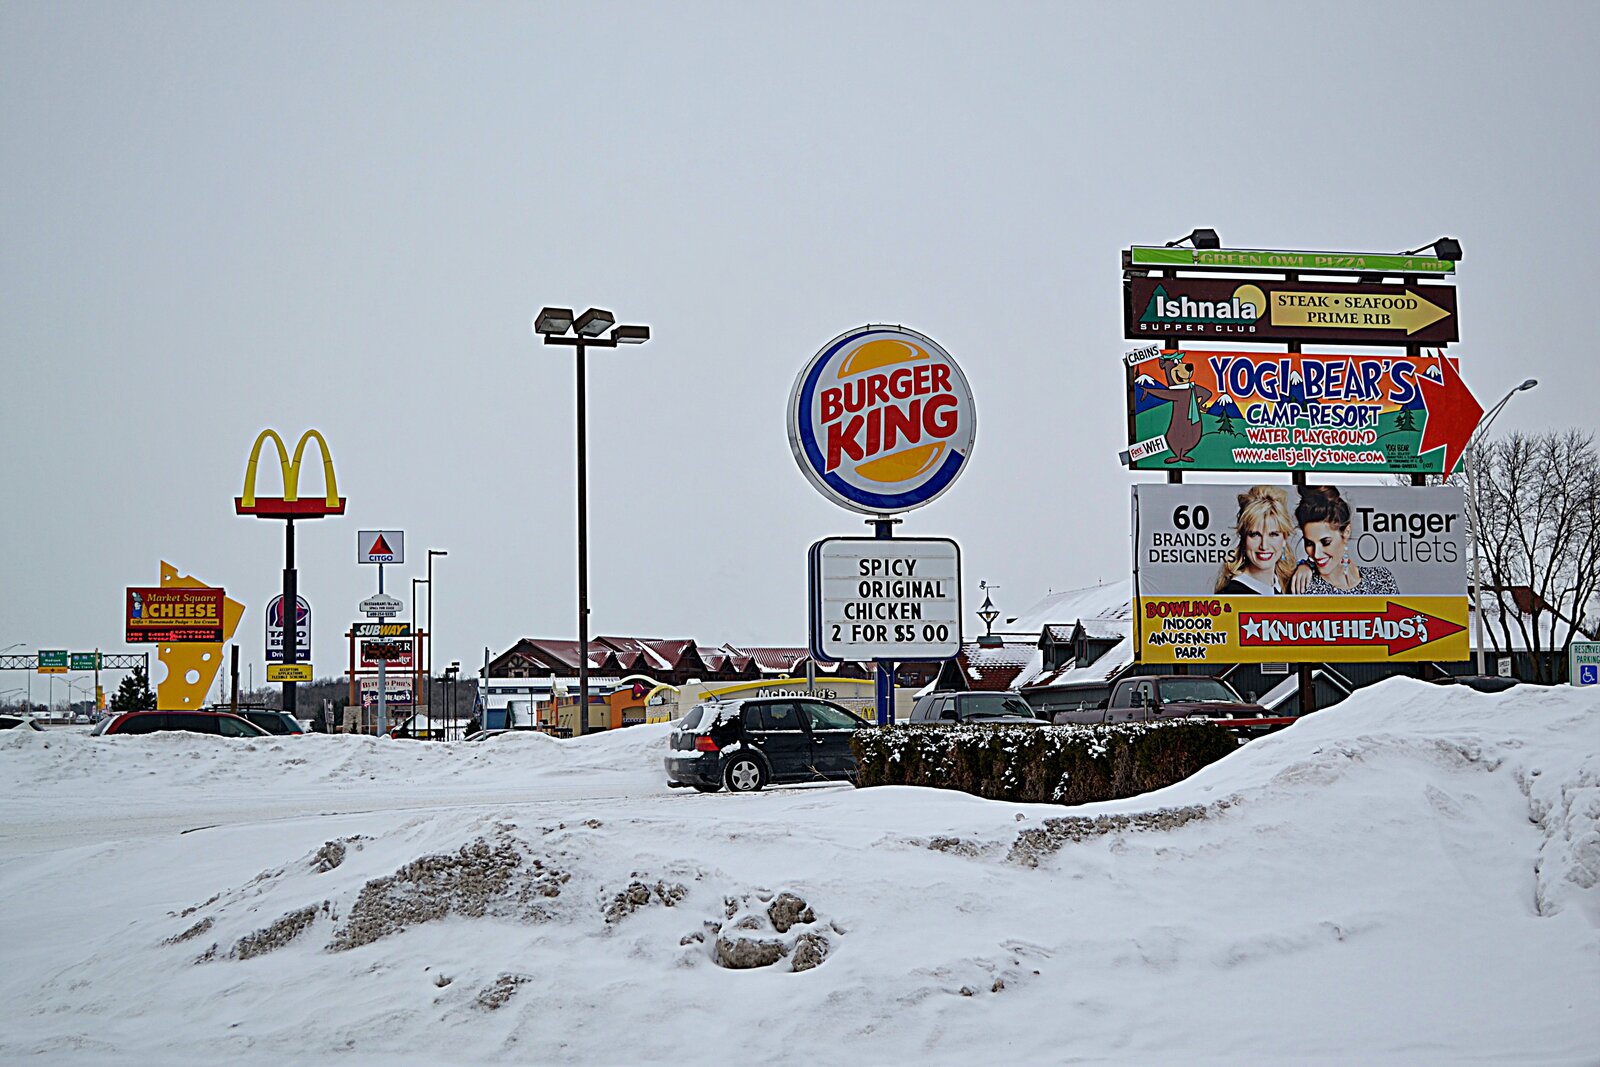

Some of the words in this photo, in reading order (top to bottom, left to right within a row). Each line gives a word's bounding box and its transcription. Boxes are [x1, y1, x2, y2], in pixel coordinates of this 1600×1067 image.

[1200, 253, 1261, 265] GREEN
[1268, 255, 1304, 267] OWL
[1315, 256, 1366, 268] PIZZA
[1156, 295, 1256, 320] Ishnala
[1278, 295, 1329, 308] STEAK
[1344, 297, 1417, 310] SEAFOOD
[1306, 311, 1358, 325] PRIME
[1362, 312, 1390, 326] RIB
[1140, 323, 1204, 333] SUPPER
[1215, 324, 1256, 333] CLUB
[1128, 346, 1159, 363] CABINS
[1209, 356, 1292, 400] YOGI
[1301, 357, 1415, 402] BEAR'S
[820, 363, 953, 425] BURGER
[1247, 404, 1381, 427] CAMP-RESORT
[826, 394, 959, 473] KING
[1248, 429, 1289, 443] WATER
[1294, 429, 1376, 444] PLAYGROUND
[1173, 505, 1210, 530] 60
[1356, 507, 1457, 539] Tanger
[1153, 533, 1216, 547] BRANDS
[1220, 533, 1231, 547] &
[1357, 533, 1458, 563] Outlets
[368, 554, 393, 563] CITGO
[1149, 549, 1237, 563] DESIGNERS
[859, 558, 917, 576] SPICY
[860, 580, 945, 599] ORIGINAL
[147, 593, 180, 602] Market
[183, 593, 216, 604] Square
[149, 603, 217, 618] CHEESE
[844, 602, 922, 621] CHICKEN
[1146, 600, 1221, 618] BOWLING
[1223, 603, 1232, 613] &
[356, 624, 408, 636] SUBWAY
[1163, 618, 1212, 630] INDOOR
[1261, 618, 1415, 642] KNUCKLEHEADS
[832, 624, 841, 642] 2
[852, 624, 890, 642] FOR
[895, 624, 915, 642] $5
[923, 624, 949, 642] 00
[1148, 632, 1227, 645] AMUSEMENT
[1175, 647, 1206, 659] PARK
[1574, 645, 1600, 654] RESERVE
[758, 689, 836, 699] McDonald's
